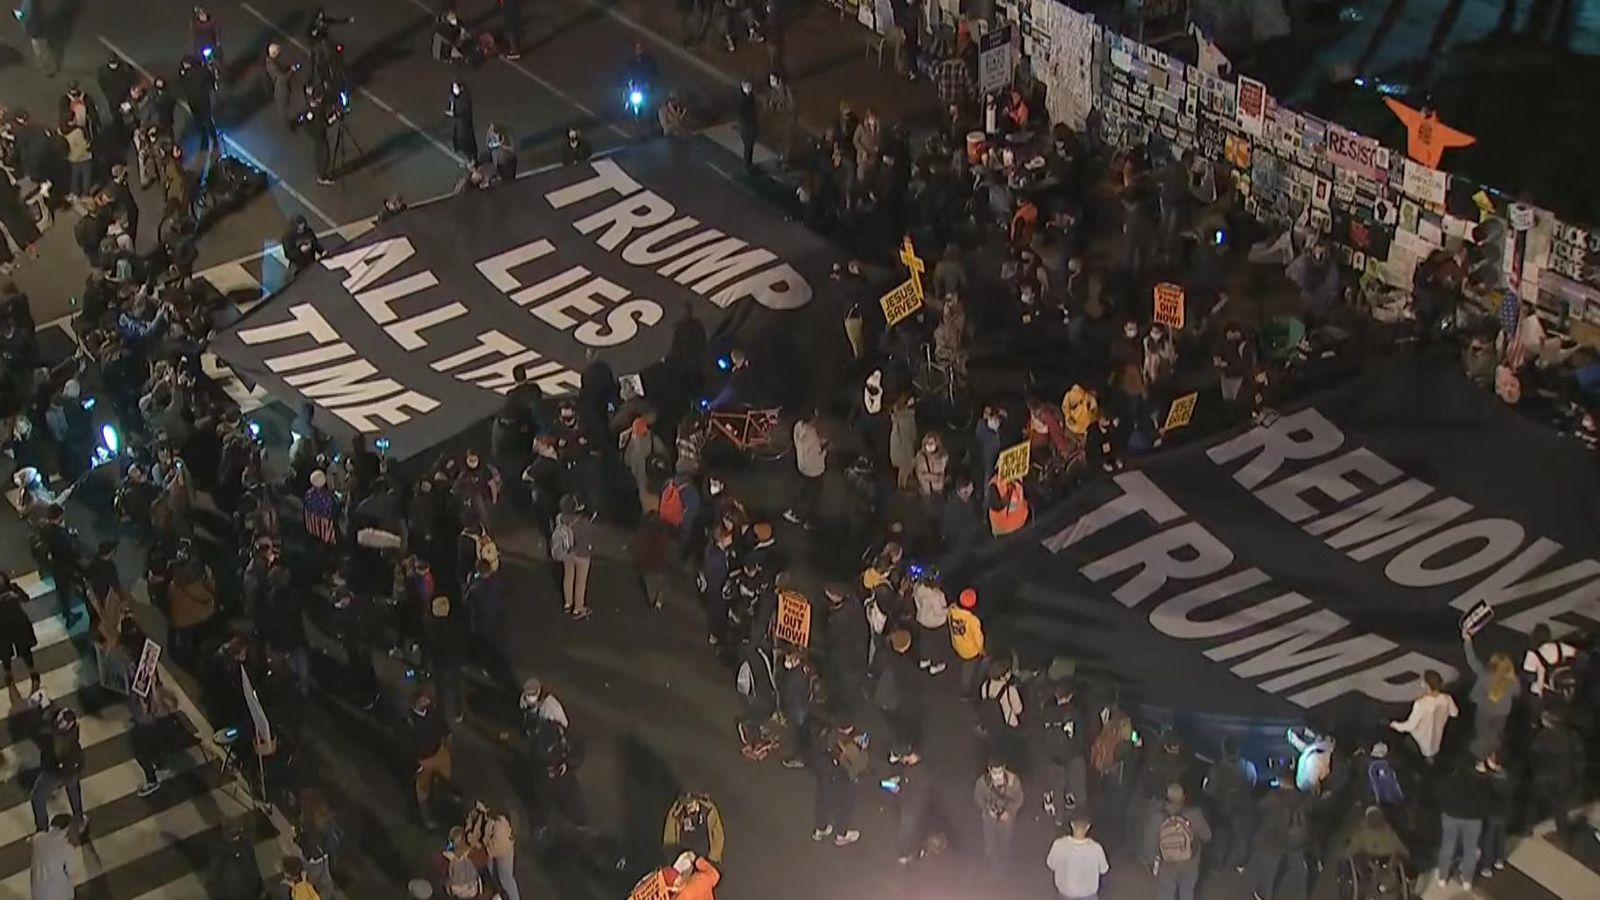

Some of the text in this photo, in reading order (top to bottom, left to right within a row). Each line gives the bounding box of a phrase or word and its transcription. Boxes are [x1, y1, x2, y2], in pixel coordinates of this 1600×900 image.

[544, 157, 813, 310] TRUMP
[320, 236, 583, 395] ALL THE
[474, 238, 664, 346] LIES
[885, 283, 915, 311] JESUS
[887, 296, 919, 321] SAVES
[1156, 312, 1181, 326] NOW!
[1160, 303, 1178, 314] OUT
[236, 302, 442, 433] TIME
[1205, 407, 1600, 638] REMOVE
[783, 613, 803, 631] OUT
[1040, 470, 1460, 709] TRUMP
[778, 624, 806, 646] NOW!
